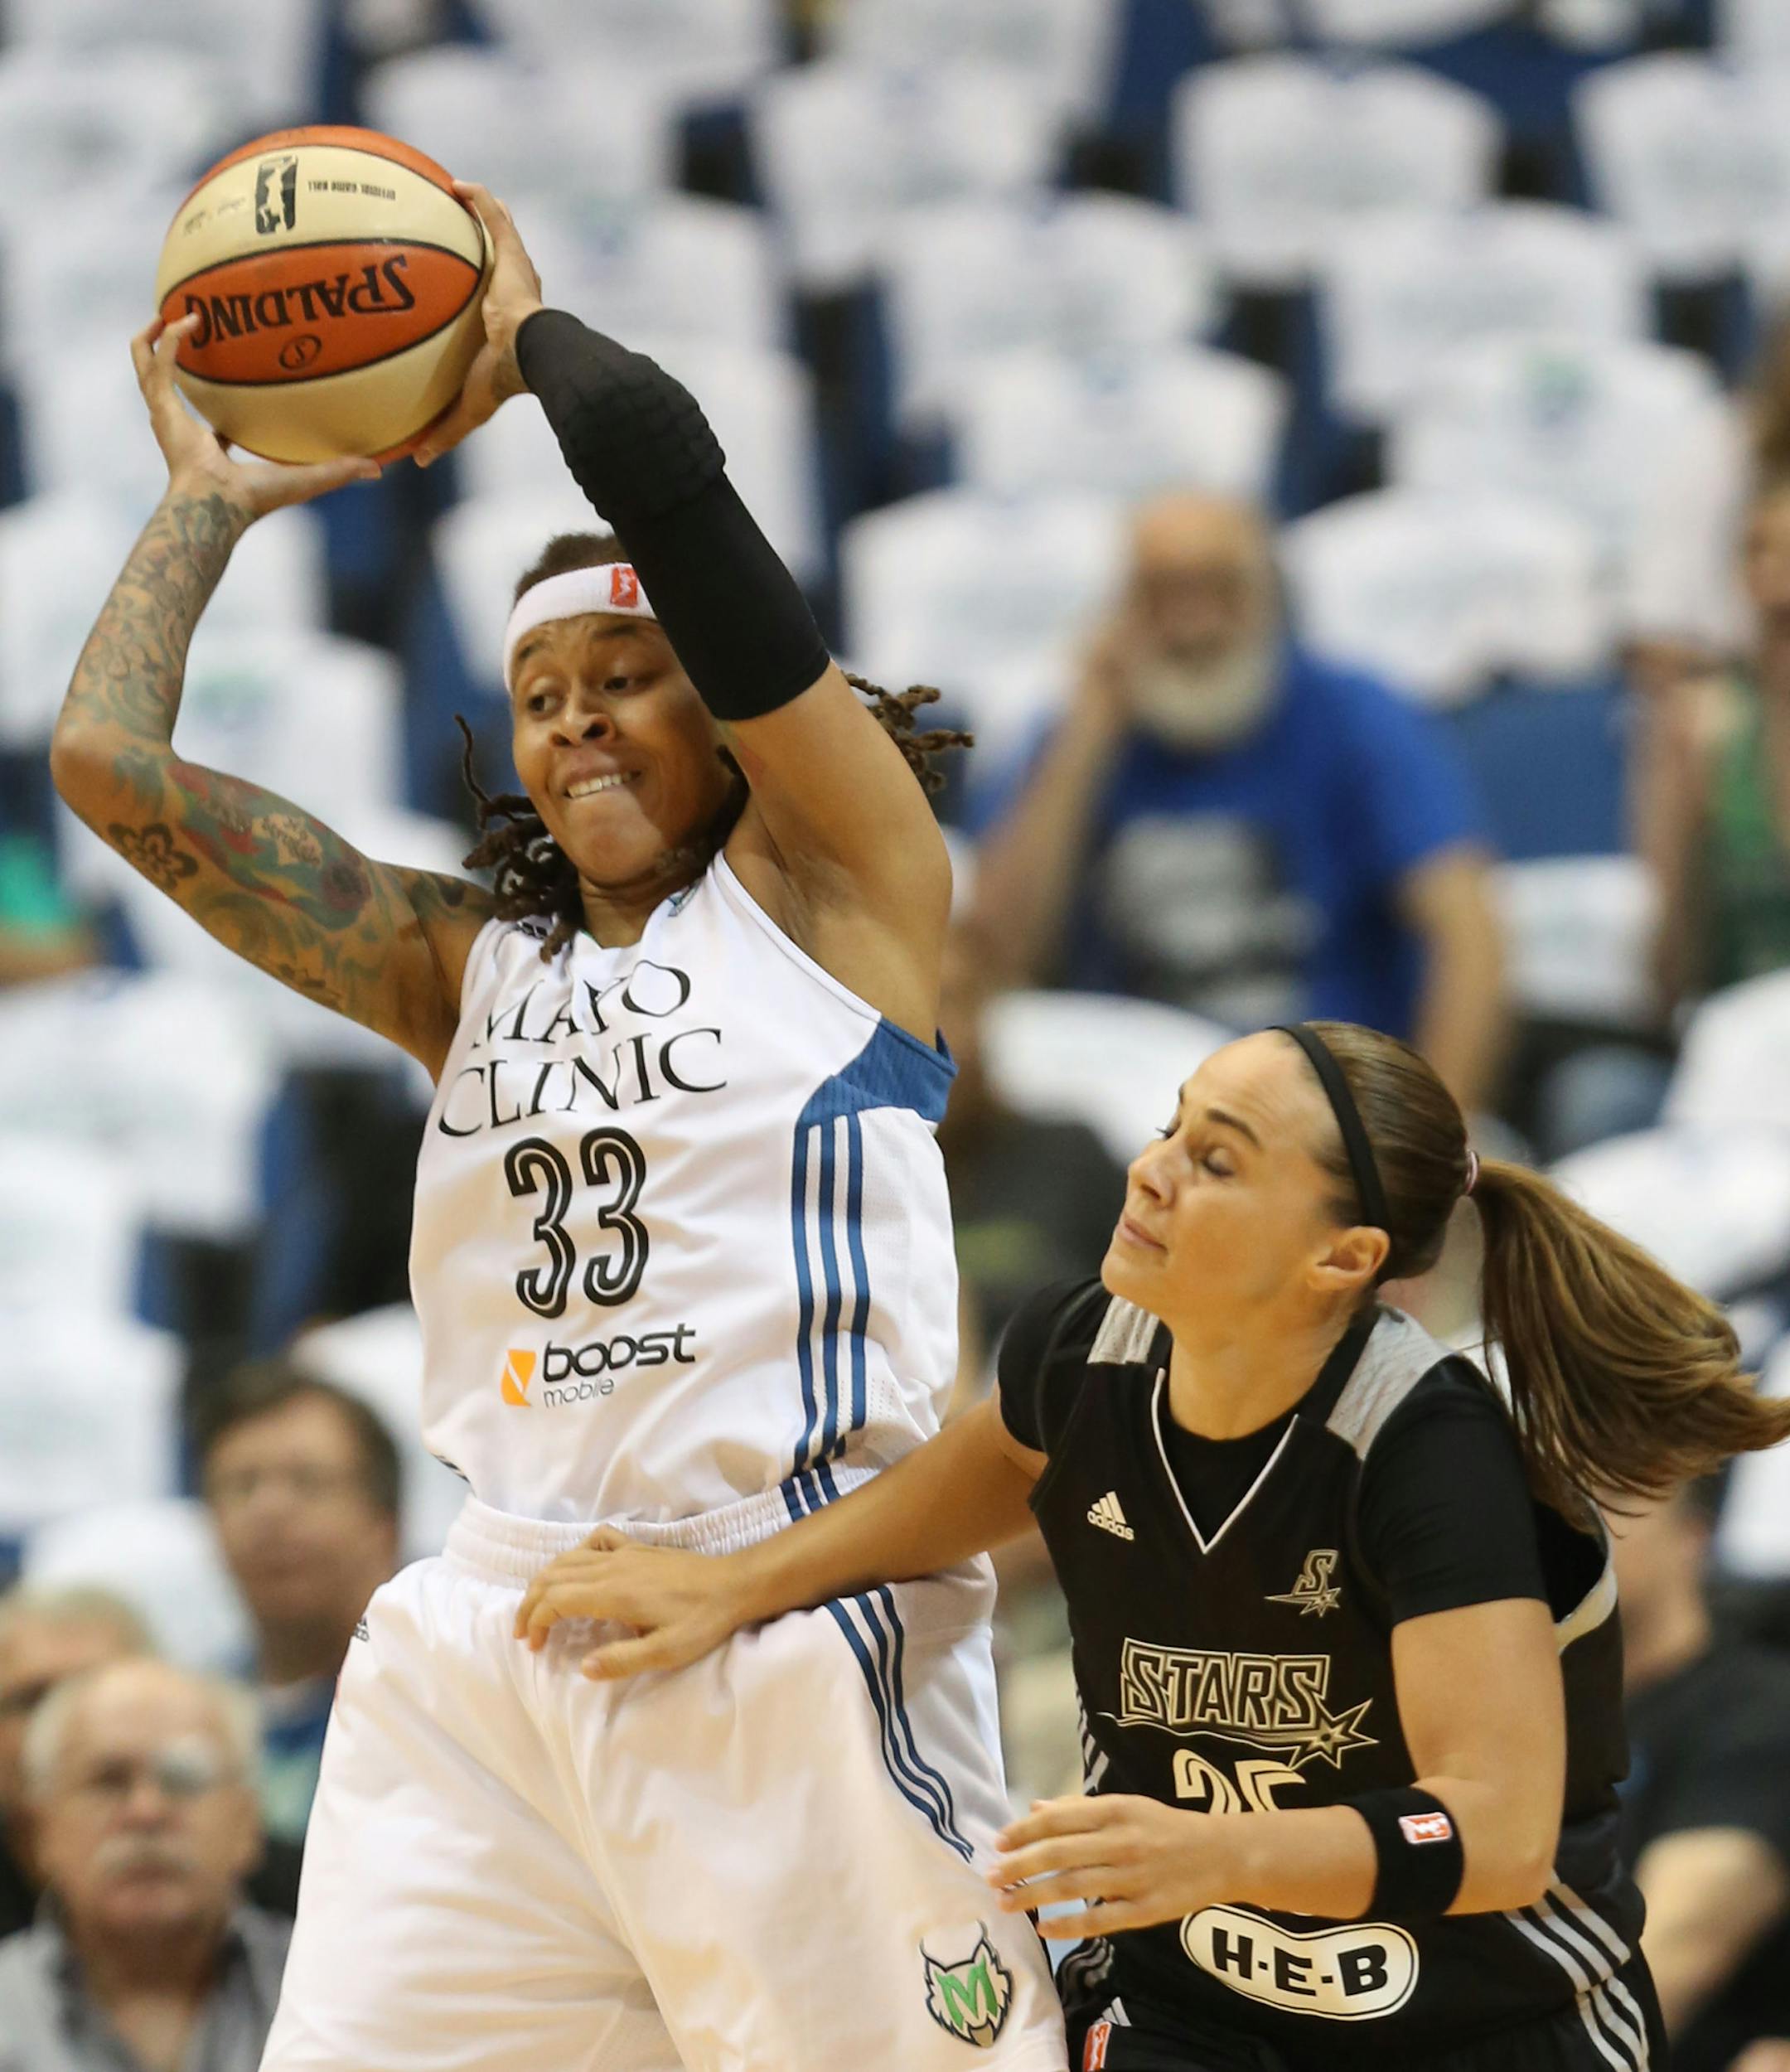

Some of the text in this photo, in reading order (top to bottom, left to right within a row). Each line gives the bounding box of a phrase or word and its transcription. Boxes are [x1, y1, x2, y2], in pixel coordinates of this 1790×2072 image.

[184, 254, 416, 350] SPALDING
[471, 959, 690, 1049] MAYO
[438, 1028, 728, 1136] CLINIC
[504, 1126, 649, 1319] 33
[542, 1323, 696, 1382] boost
[543, 1377, 615, 1408] mobile
[1086, 1510, 1134, 1542] adidas
[1120, 1637, 1331, 1729] STARS
